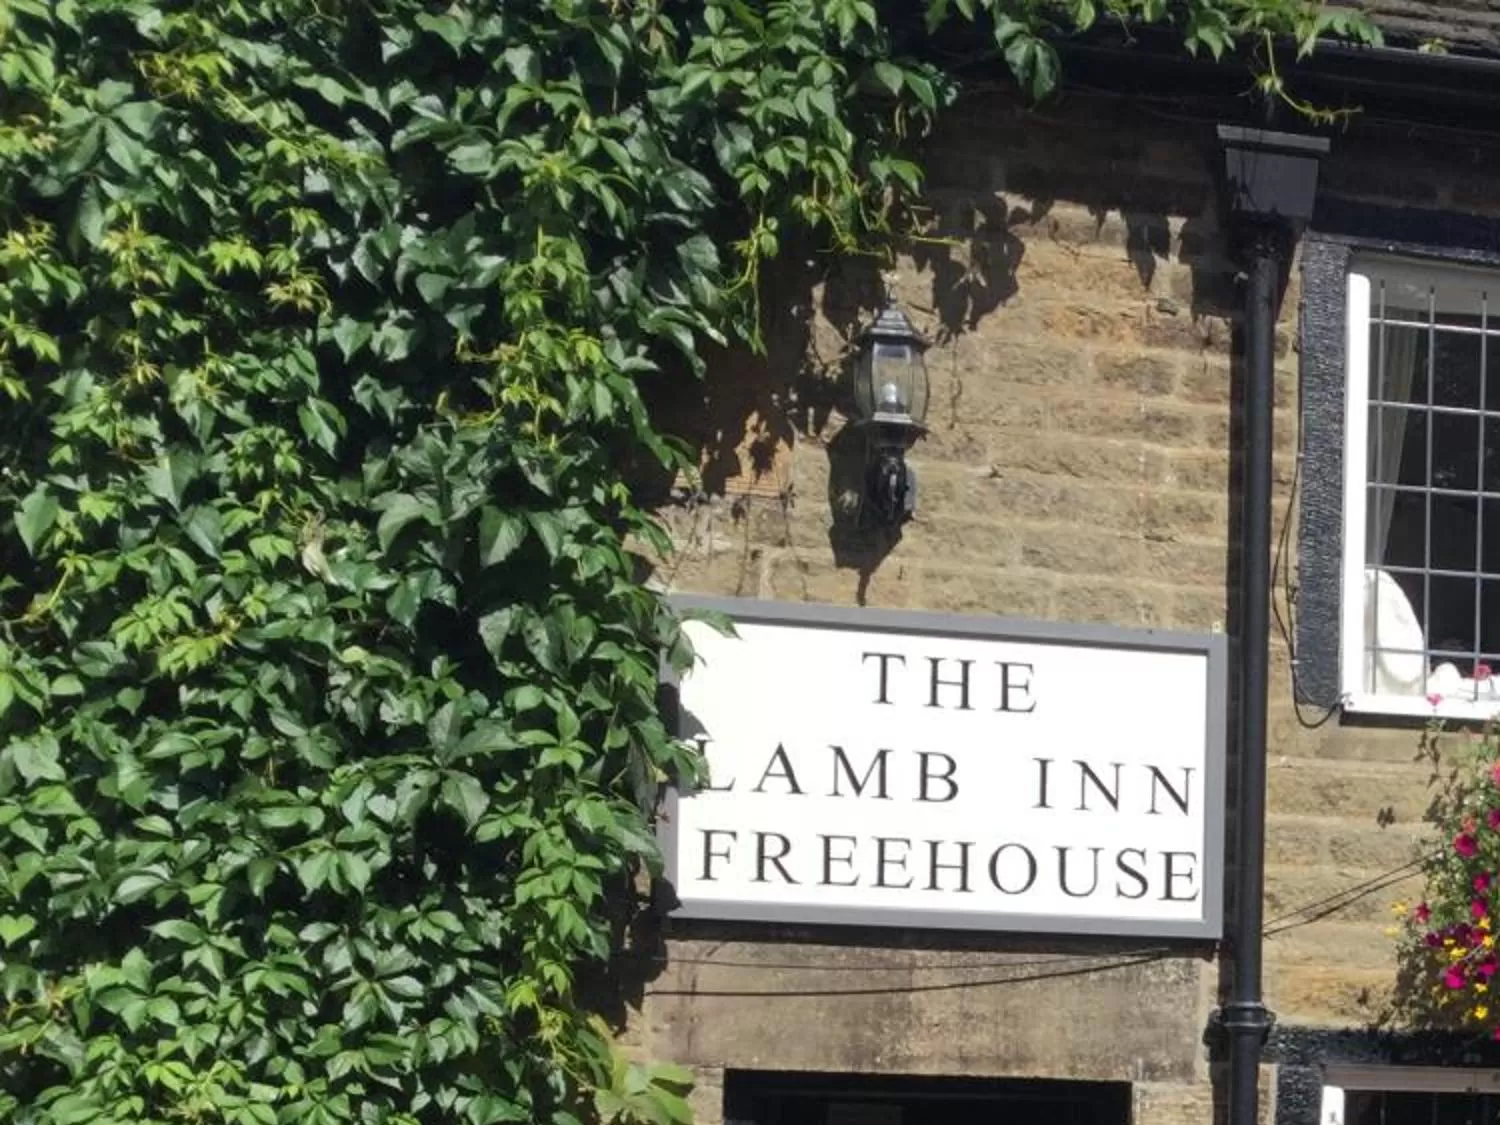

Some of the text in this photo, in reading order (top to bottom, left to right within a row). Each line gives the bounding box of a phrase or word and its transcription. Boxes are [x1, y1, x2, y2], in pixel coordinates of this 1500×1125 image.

[862, 651, 1037, 713] THE
[1032, 757, 1195, 816] INN
[697, 829, 1200, 902] FREEHOUSE
